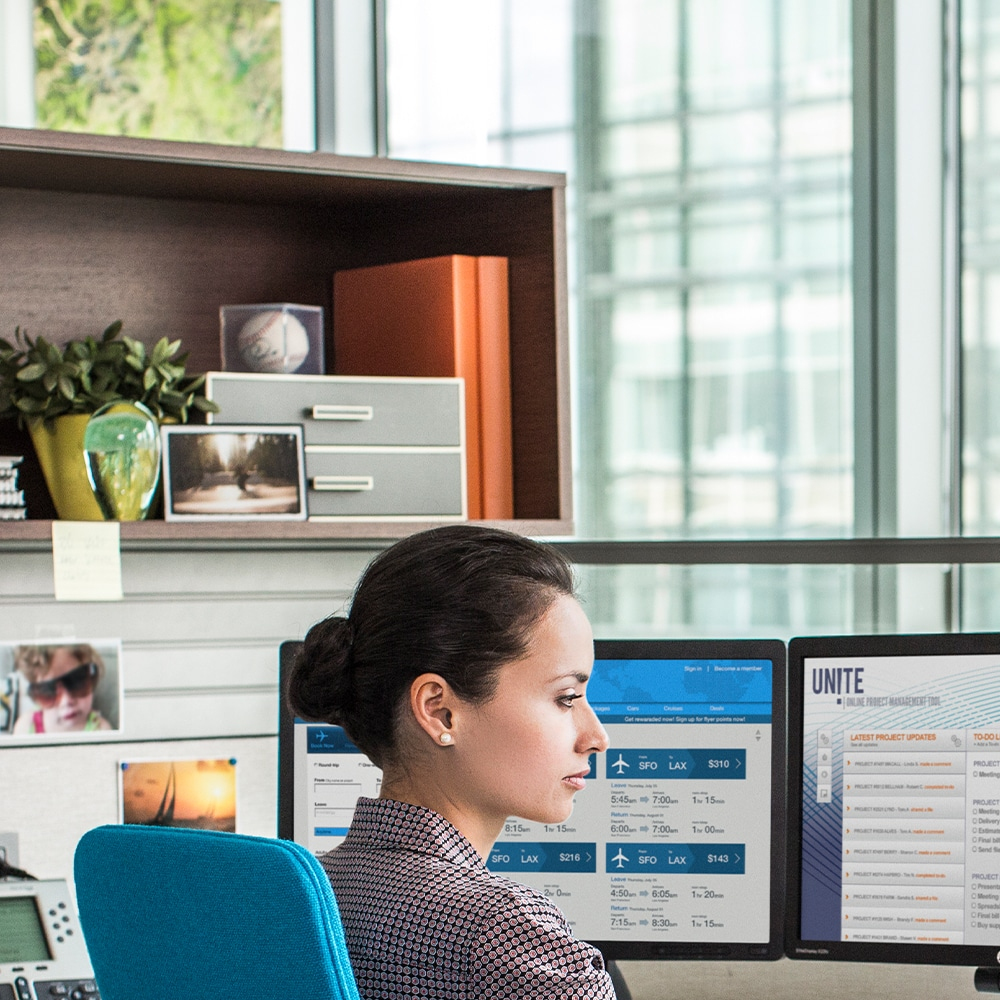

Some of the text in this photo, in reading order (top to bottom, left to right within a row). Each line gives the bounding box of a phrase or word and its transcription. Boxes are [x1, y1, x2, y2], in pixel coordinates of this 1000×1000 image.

[847, 696, 941, 707] ONLINE PROJECT MANAGEMENT TOOL
[906, 733, 936, 741] UPDATES
[639, 759, 729, 770] SFO LAX $310
[652, 796, 678, 804] 7:00am
[611, 825, 637, 833] 6:00am
[652, 825, 678, 833] 7:00am
[492, 853, 580, 863] SFO LAX $216
[639, 854, 729, 864] SFO LAX $143
[611, 889, 636, 897] 4:50am
[652, 890, 678, 898] 6:05am
[611, 918, 636, 926] 7:15am
[652, 919, 678, 927] 8:30am
